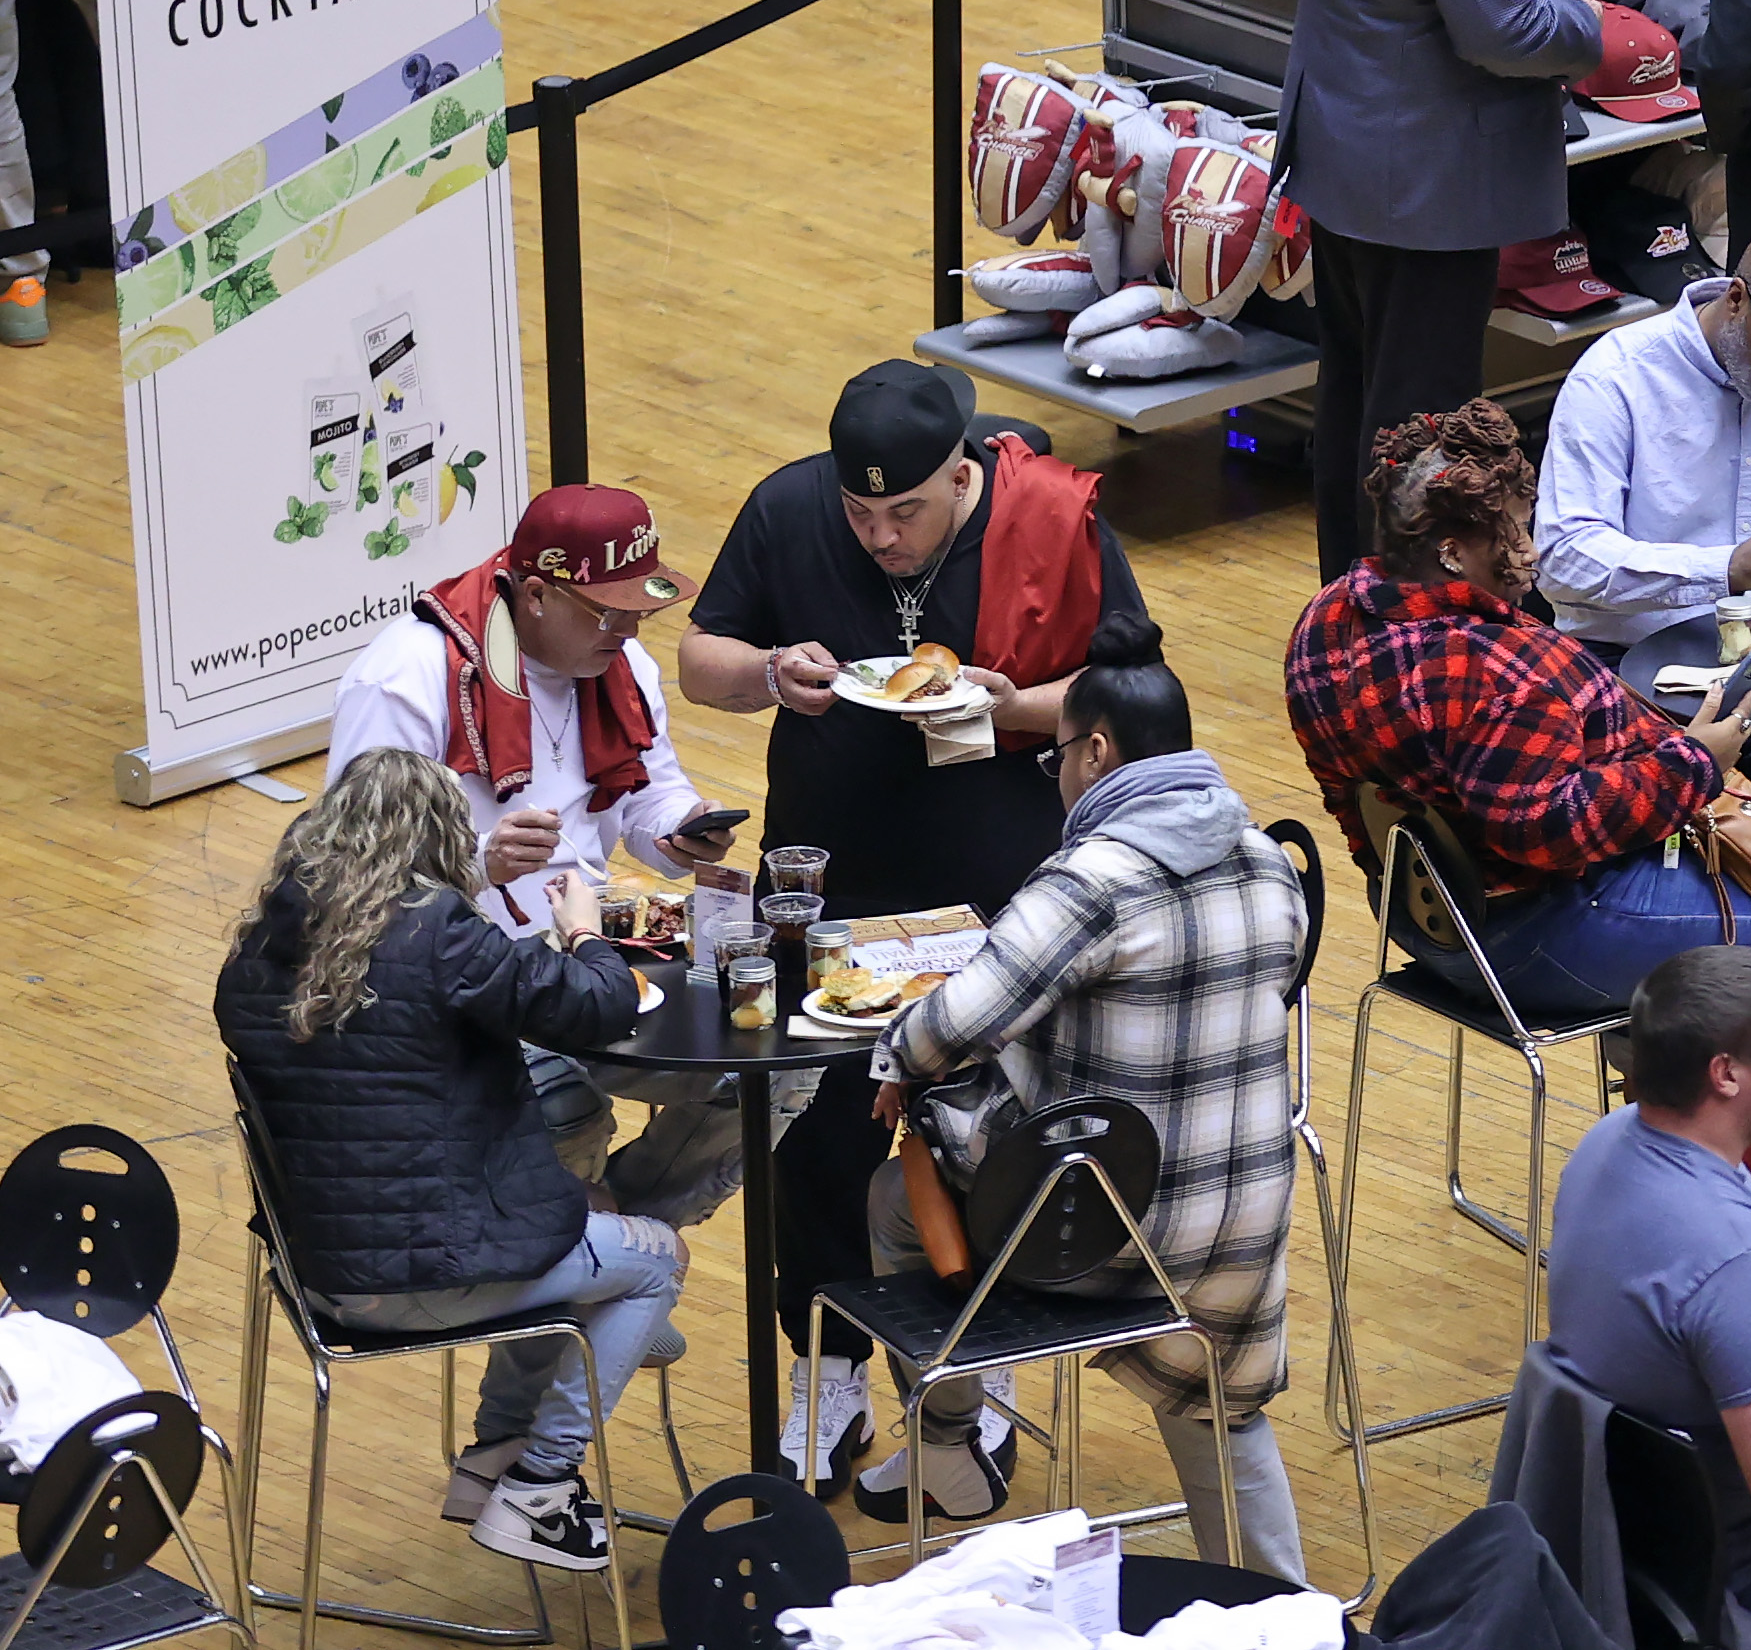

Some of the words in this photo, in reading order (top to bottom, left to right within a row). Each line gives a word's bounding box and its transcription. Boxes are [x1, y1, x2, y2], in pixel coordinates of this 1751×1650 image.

[976, 133, 1038, 161] CHARGE
[1169, 208, 1238, 237] CHARGE
[316, 421, 353, 442] MOJITO
